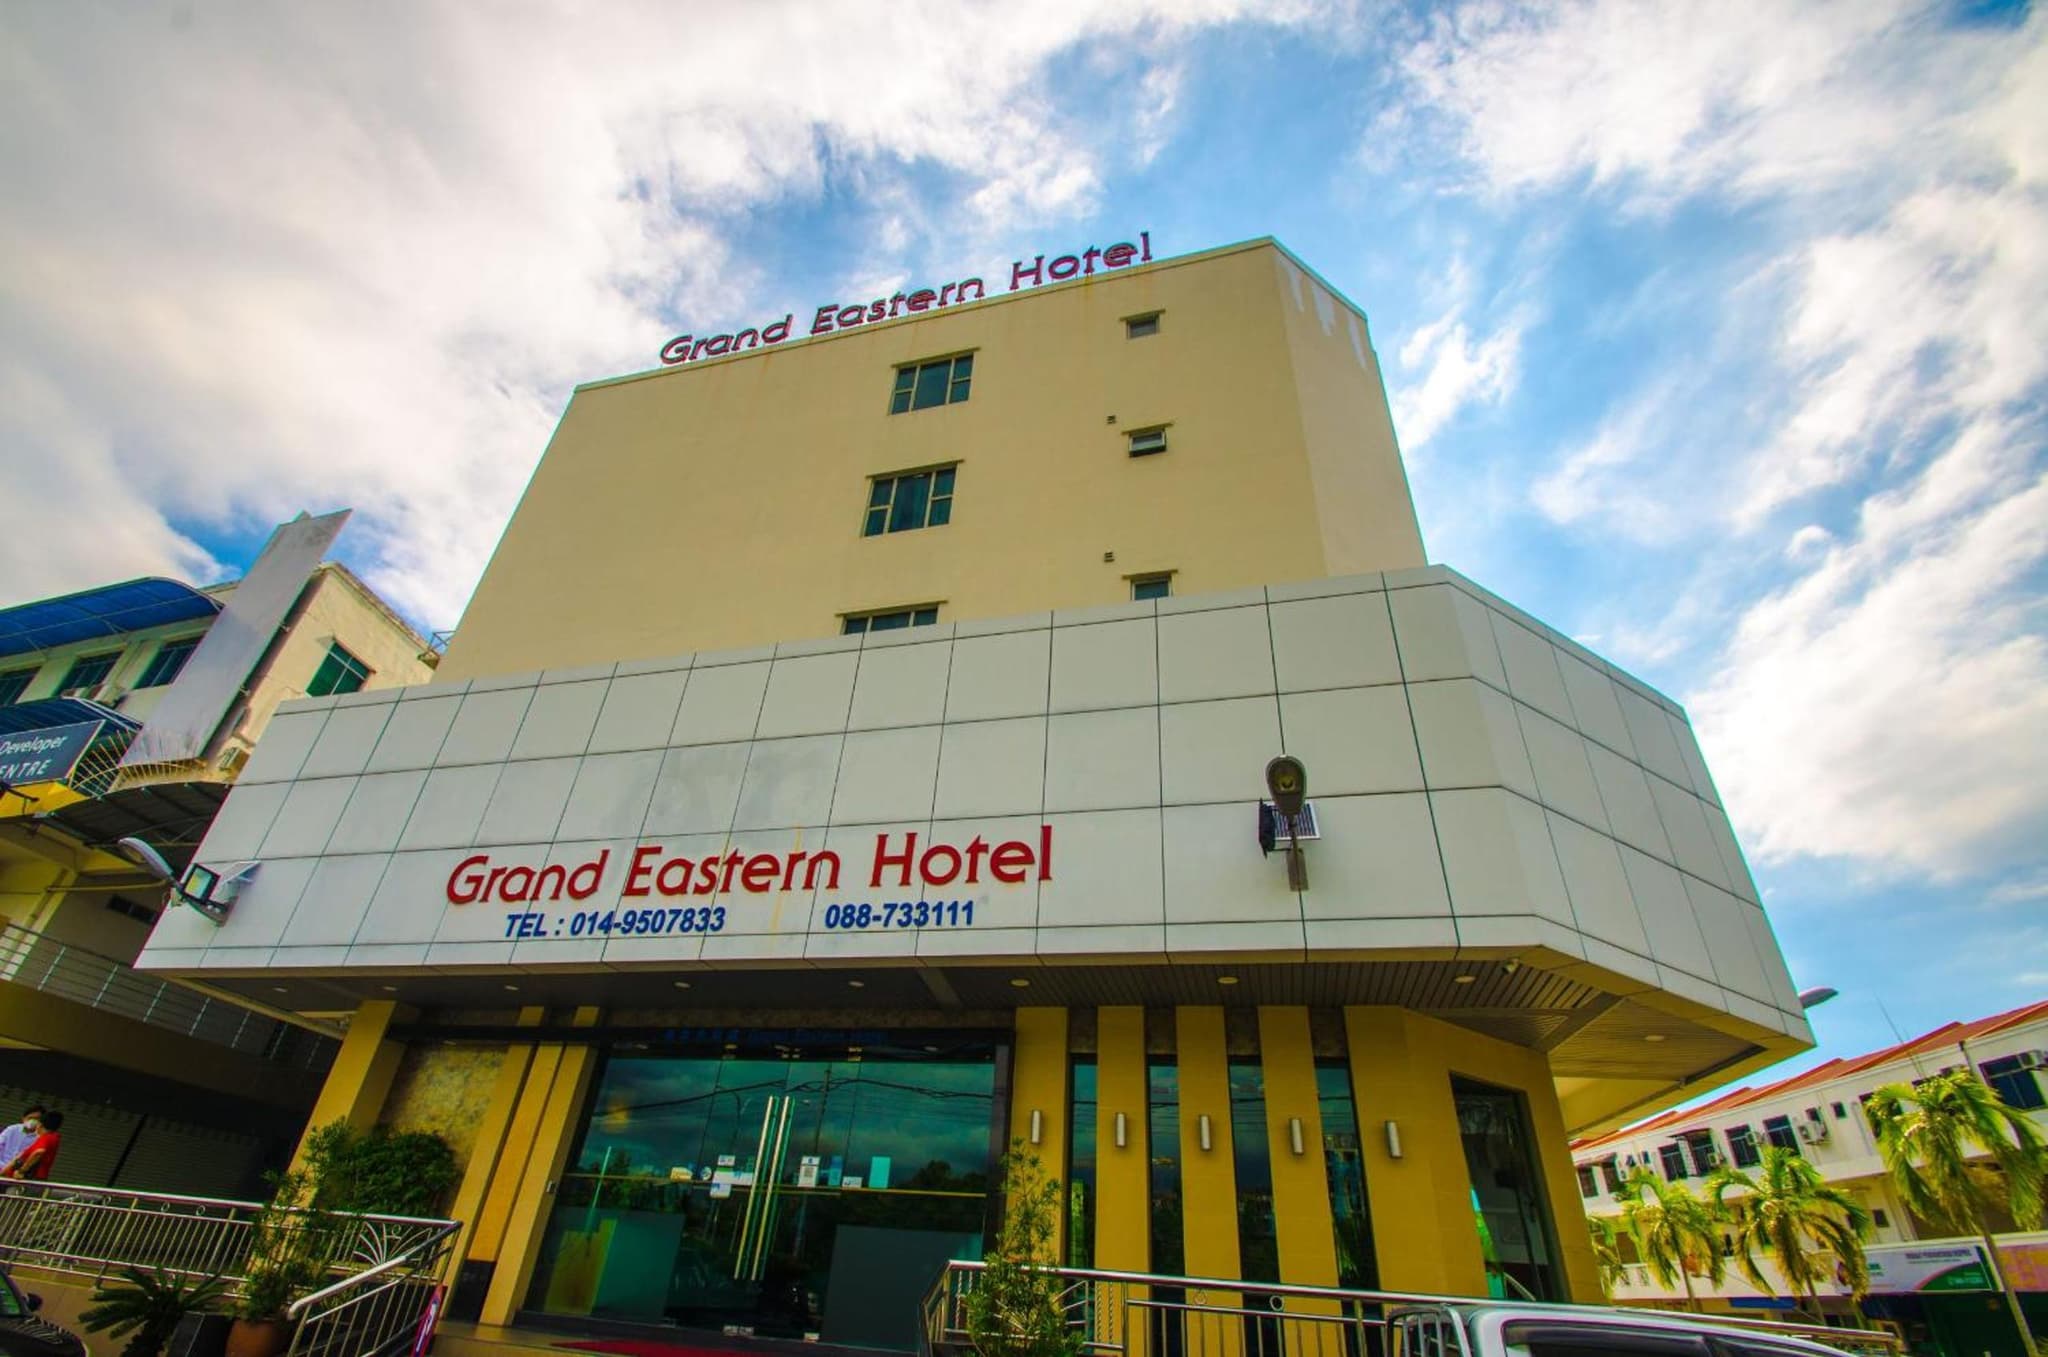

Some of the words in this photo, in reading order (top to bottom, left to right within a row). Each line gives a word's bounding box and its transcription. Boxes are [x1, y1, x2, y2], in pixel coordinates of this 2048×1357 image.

[660, 314, 793, 365] Grand
[810, 277, 985, 335] Eastern
[1009, 231, 1153, 290] Hotel
[0, 736, 68, 755] Developer
[446, 849, 610, 905] Grand
[622, 845, 841, 897] Eastern
[869, 825, 1053, 887] Hotel
[504, 913, 548, 938] TEL
[570, 907, 726, 936] 014-9507833
[825, 901, 974, 929] 088-733111
